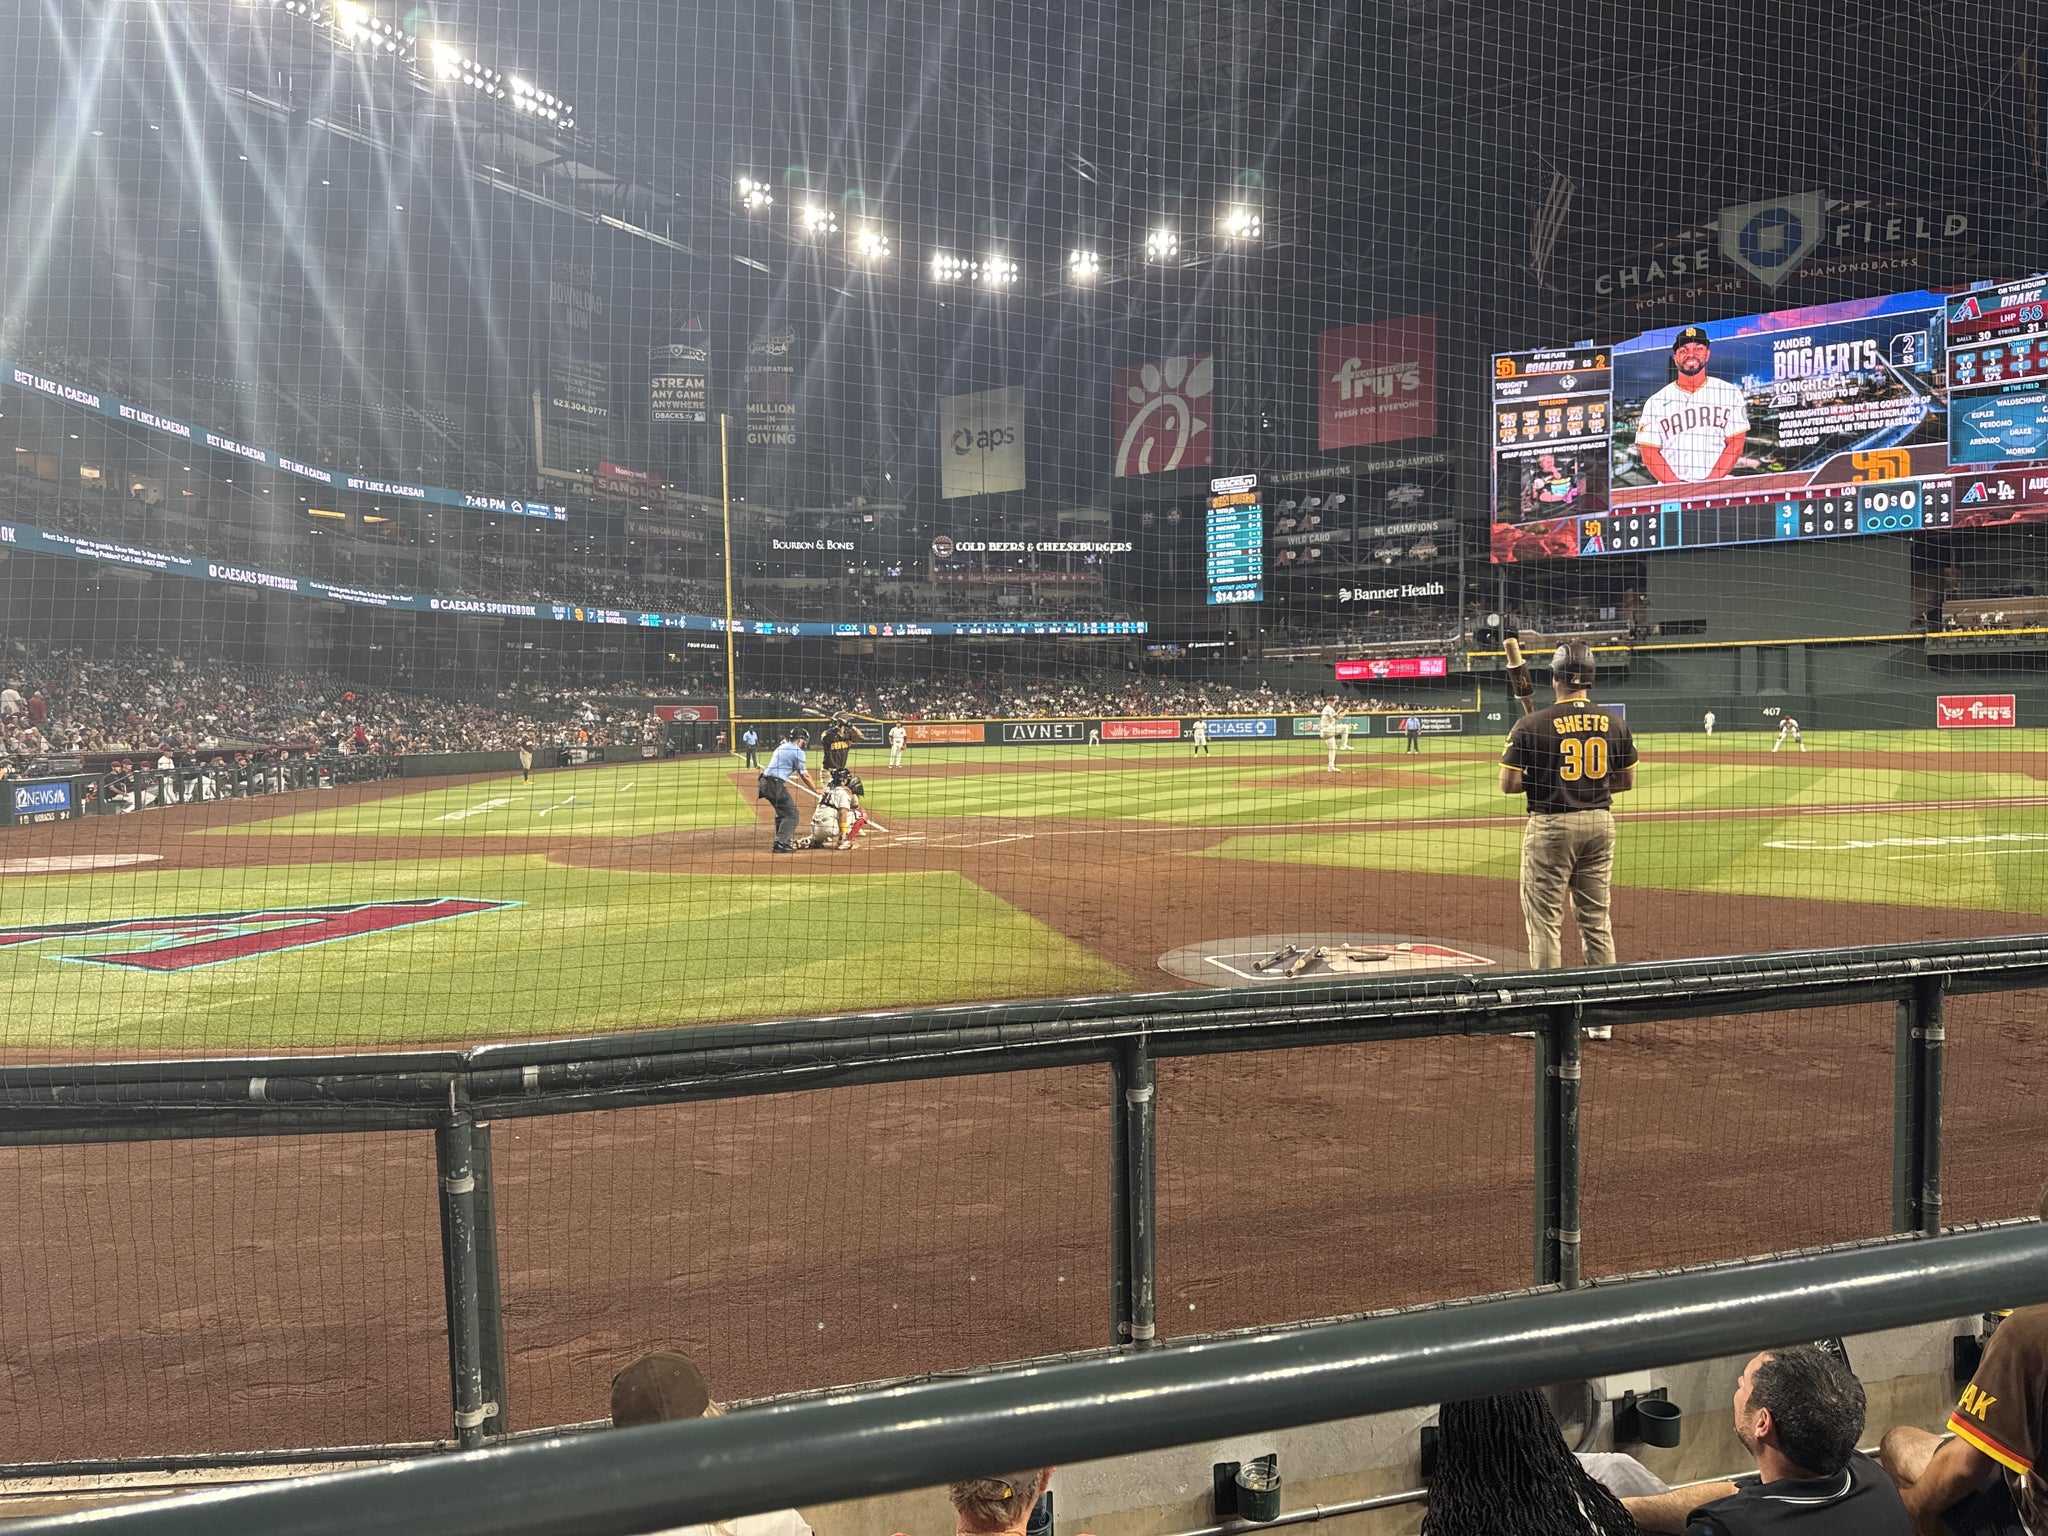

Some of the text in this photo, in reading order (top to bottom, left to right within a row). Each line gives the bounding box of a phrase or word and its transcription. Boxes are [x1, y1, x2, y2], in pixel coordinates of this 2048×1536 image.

[1594, 214, 1968, 296] CHASE FIELD
[1636, 258, 1918, 310] HOME OF THE DIAMONDBACKS
[2022, 280, 2046, 290] MOUND
[2001, 290, 2042, 308] DRAKE
[2000, 304, 2043, 322] LHP 58
[1978, 331, 1991, 340] 30
[1998, 327, 2020, 335] STRIKES
[2028, 322, 2039, 332] 31
[1774, 336, 1811, 350] XANDER
[1903, 336, 1914, 354] 2
[1526, 354, 1605, 373] BOGAERTS SS 2
[1774, 340, 1876, 380] BOGAERTS
[1903, 355, 1914, 364] SS
[651, 378, 704, 388] STREAM
[1332, 357, 1420, 400] fry's
[14, 370, 100, 408] BET LIKE A CAESAR
[652, 390, 704, 399] ANY GAME
[1502, 388, 1522, 396] GAME
[1774, 381, 1826, 394] TONIGHT:
[1806, 390, 1837, 401] LINEOUT
[554, 399, 607, 416] 623.304.0777
[746, 404, 796, 414] MILLION
[1779, 411, 1794, 420] WAS
[1796, 408, 1829, 418] KNIGHTED
[1854, 404, 1864, 412] BY
[1865, 402, 1880, 411] THE
[1880, 398, 1920, 409] GOVERNOR
[1920, 396, 1932, 404] OF
[1996, 396, 2046, 406] WALDSCHMIDT
[1335, 400, 1419, 420] FRESH FOR EVERYONE
[1972, 410, 1994, 419] KEPLER
[120, 405, 190, 438] BET LIKE A CAESAR
[1660, 406, 1731, 440] PADRES
[1779, 408, 1920, 430] ARUBA AFTER HELPING THE NETHERLANDS
[1779, 430, 1792, 438] WIN
[1800, 426, 1818, 436] GOLD
[1820, 424, 1844, 434] MEDAL
[1854, 422, 1867, 430] THE
[1886, 416, 1921, 427] BASEBALL
[1980, 420, 2012, 428] PERDOMO
[748, 434, 796, 444] GIVING
[976, 426, 1016, 452] aps
[2010, 428, 2032, 436] DRAKE
[206, 434, 266, 462] BET LIKE A CAESAR
[1779, 436, 1819, 448] WORLD CUP
[1970, 437, 2000, 445] ARENADO
[2006, 447, 2036, 455] MORENO
[280, 458, 331, 482] BET LIKE A CAESAR
[1368, 454, 1444, 472] WORLD CHAMPIONS
[615, 467, 646, 478] Honeywell
[1270, 466, 1350, 483] NL WEST CHAMPIONS
[348, 478, 424, 498] BET LIKE A CAESAR
[599, 479, 666, 500] SANDLOT
[466, 496, 506, 510] 7:45 PM
[1865, 490, 1916, 512] B 0 S 0
[1374, 522, 1438, 536] NL CHAMPIONS
[1614, 518, 1656, 531] 1 0 2
[772, 540, 854, 550] BOURBON & BONES
[1288, 533, 1330, 546] WILD CARD
[1612, 535, 1656, 548] 0 0 1
[956, 542, 1132, 554] COLD BEERS & CHEESEBURGERS
[218, 566, 298, 591] CAESARS SPORTSBOOK
[1216, 590, 1255, 603] $14,238
[1354, 582, 1444, 601] Banner Health
[440, 600, 536, 616] CAESARS SPORTSBOOK
[1762, 708, 1780, 716] 407
[1968, 702, 2012, 720] fry's
[1013, 724, 1075, 739] AVNET
[1132, 727, 1172, 736] Budweiser
[1208, 723, 1252, 734] CHASE
[1553, 714, 1610, 734] SHEETS
[1560, 736, 1608, 781] 30
[28, 790, 54, 806] NEWS
